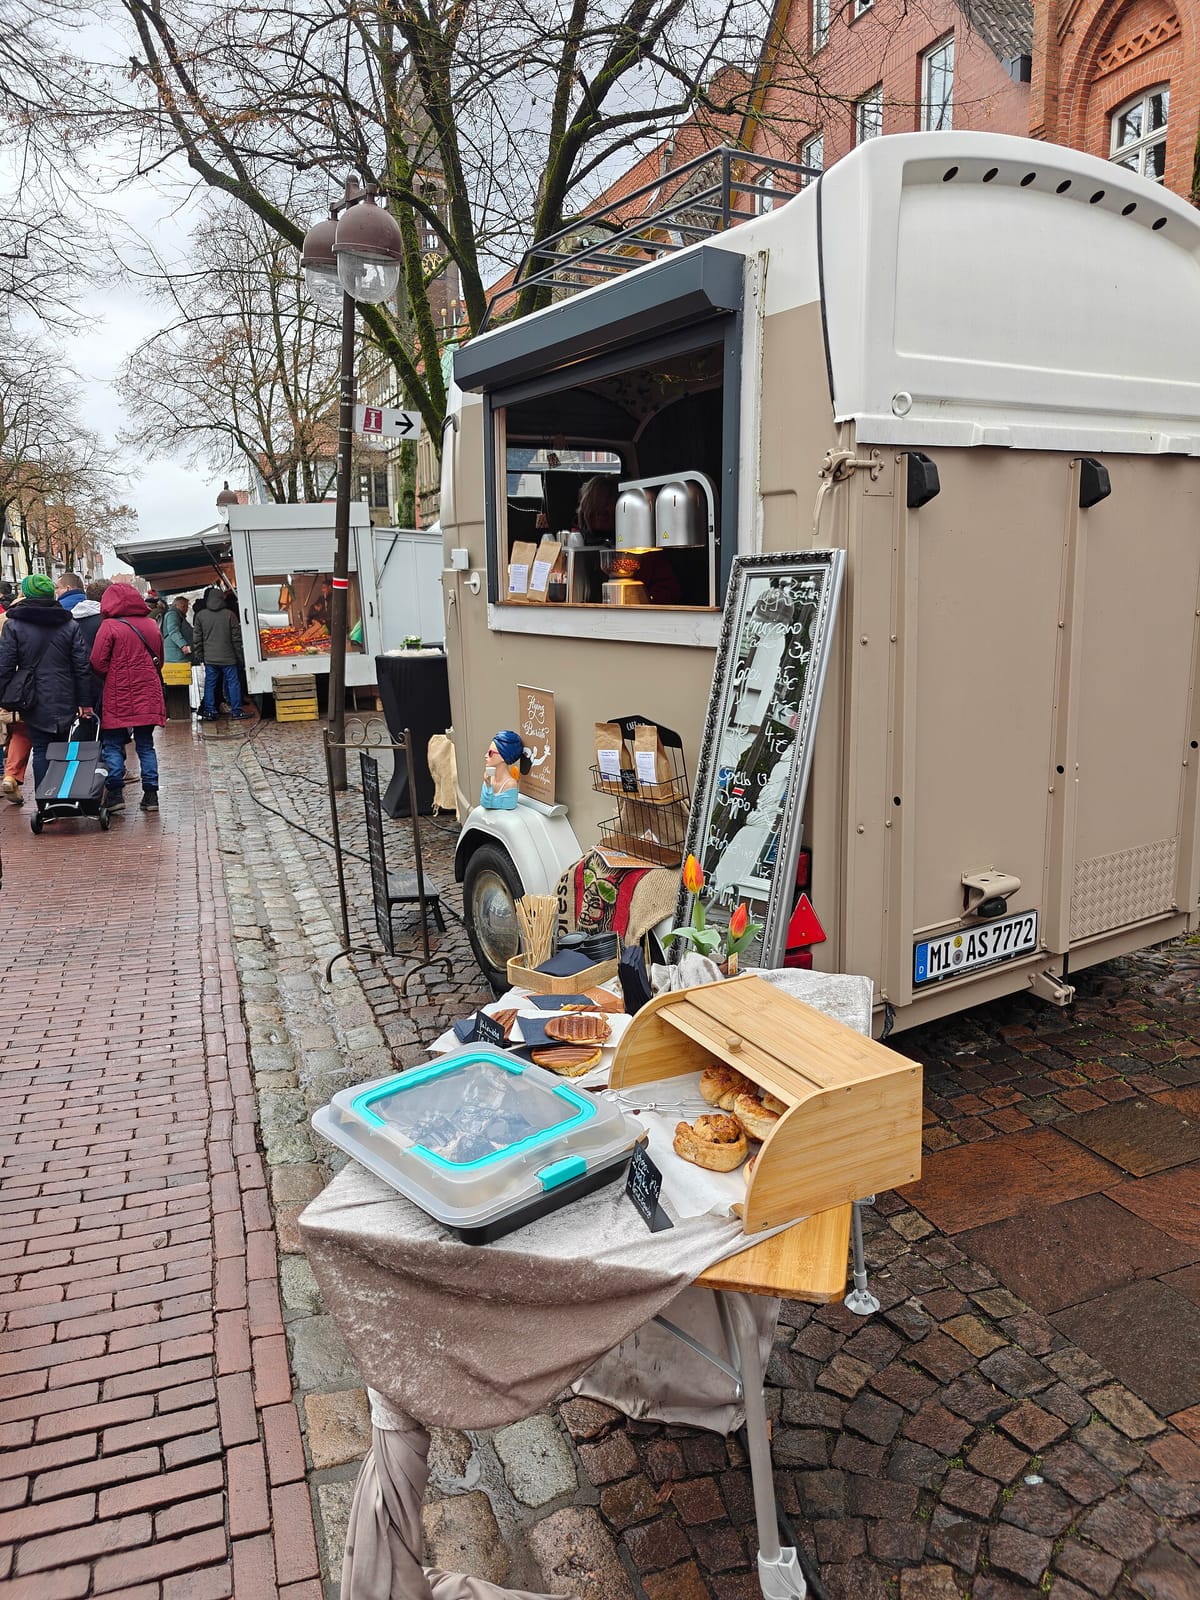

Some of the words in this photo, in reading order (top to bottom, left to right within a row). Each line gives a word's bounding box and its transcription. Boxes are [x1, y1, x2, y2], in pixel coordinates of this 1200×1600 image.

[929, 941, 951, 973] MI
[966, 931, 988, 962] AS
[992, 918, 1034, 954] 7772
[919, 965, 924, 974] D
